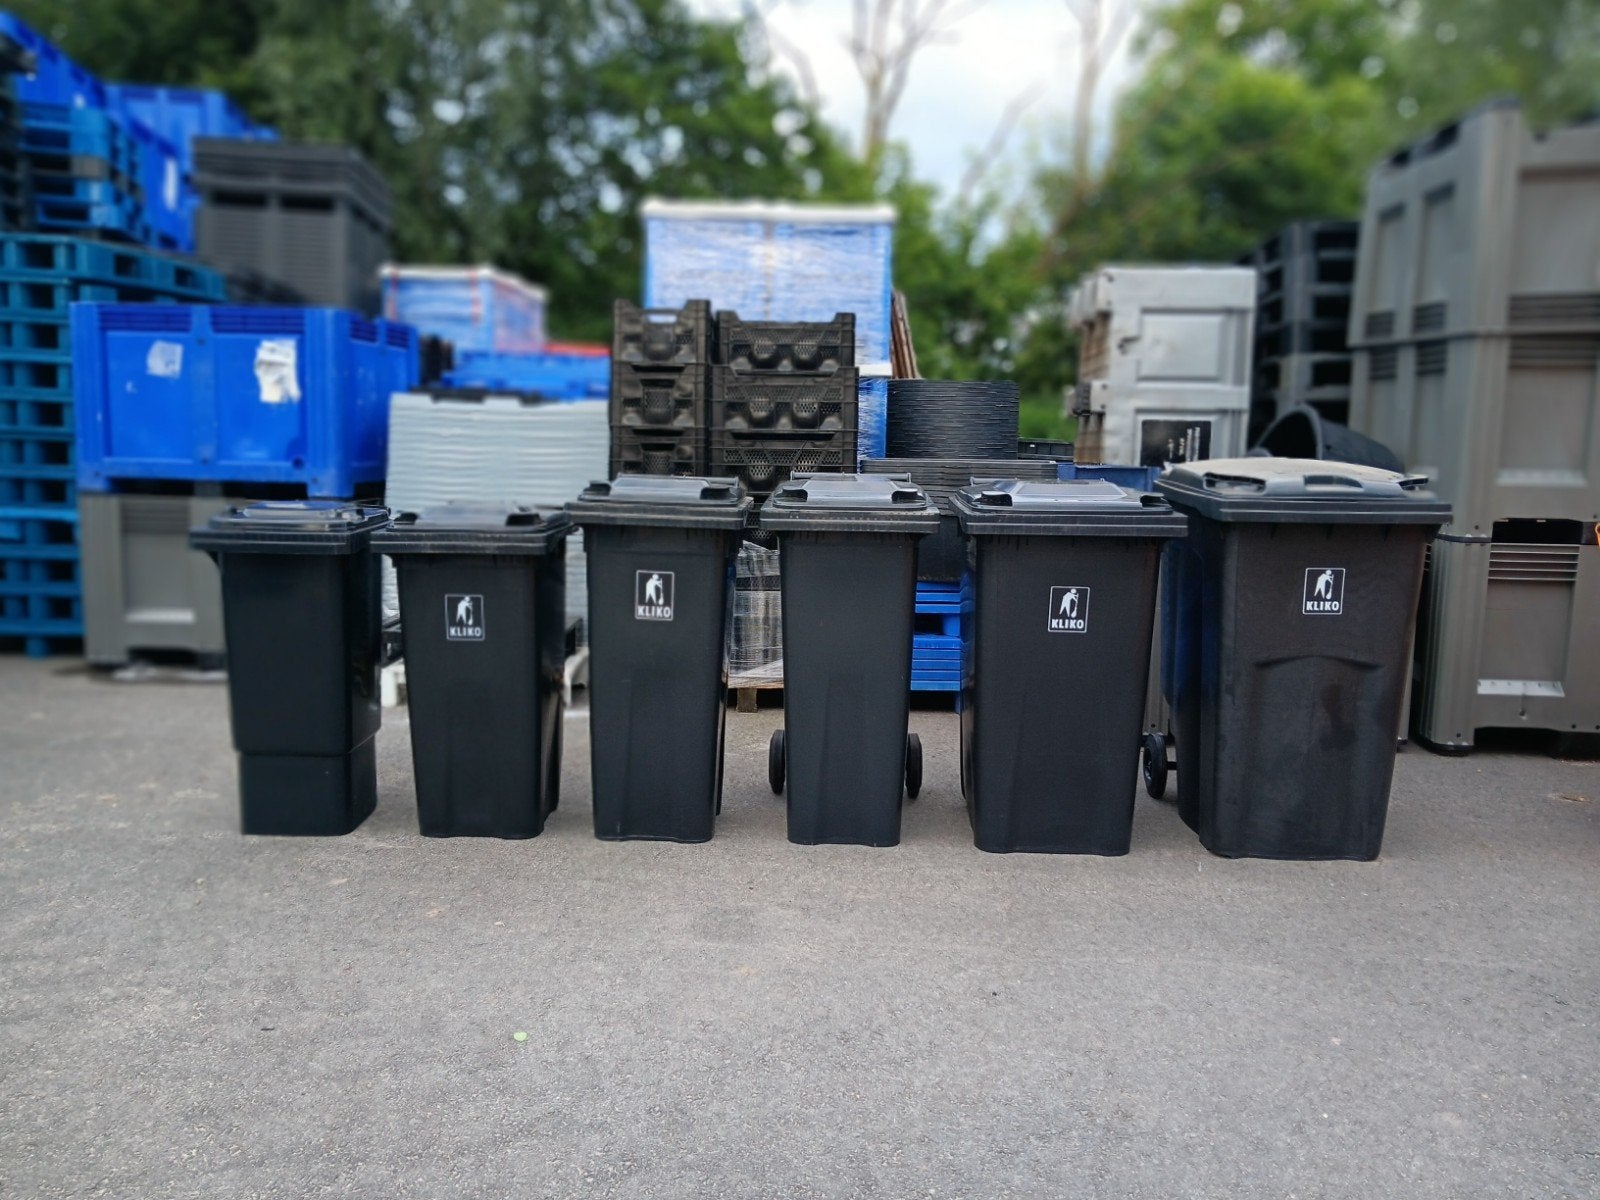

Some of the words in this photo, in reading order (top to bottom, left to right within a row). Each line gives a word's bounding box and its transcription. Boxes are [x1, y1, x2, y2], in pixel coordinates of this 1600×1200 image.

[1306, 601, 1339, 611] KLIKO
[638, 606, 671, 618] KLIKO
[1052, 619, 1084, 629] KLIKO
[450, 627, 482, 637] KLIKO
